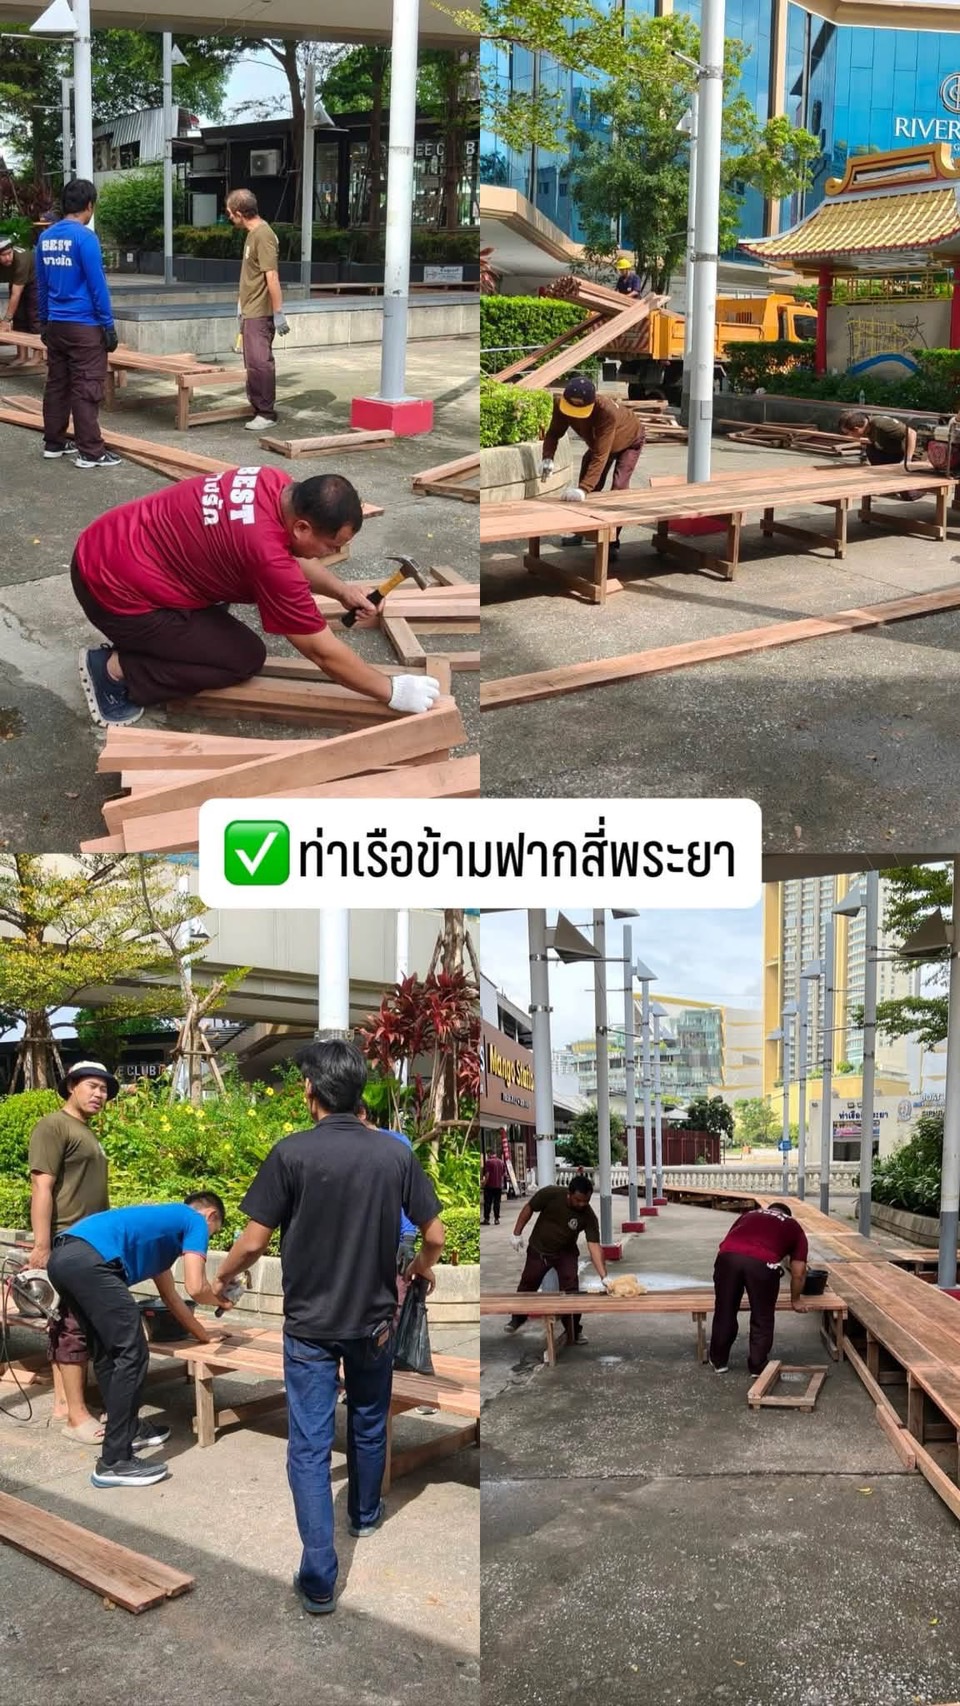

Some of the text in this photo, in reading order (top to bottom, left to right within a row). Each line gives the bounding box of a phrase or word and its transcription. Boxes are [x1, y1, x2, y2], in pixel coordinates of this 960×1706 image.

[895, 116, 960, 140] RIVER
[41, 239, 73, 252] BEST
[201, 471, 225, 526] างรัก
[229, 466, 262, 525] BEST
